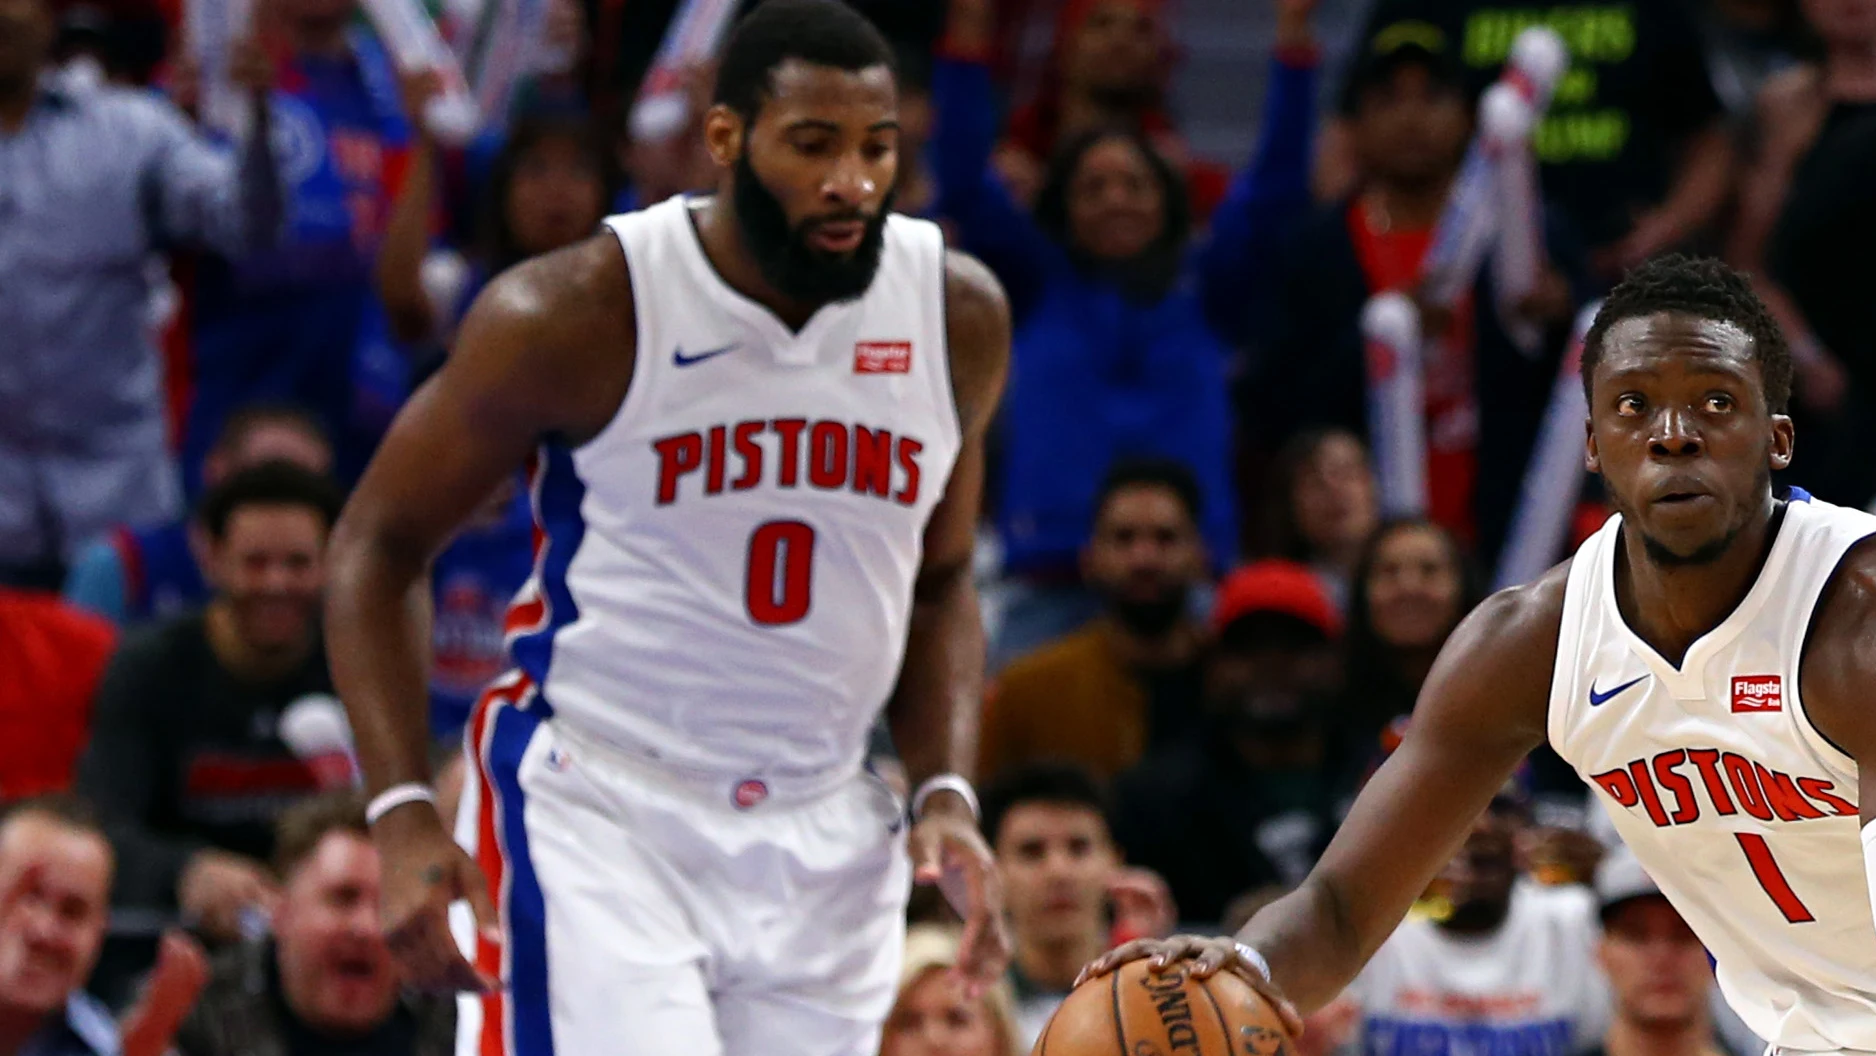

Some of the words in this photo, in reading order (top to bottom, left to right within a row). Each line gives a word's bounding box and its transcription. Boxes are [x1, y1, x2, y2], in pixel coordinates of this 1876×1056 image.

[652, 417, 923, 508] PISTONS
[746, 517, 815, 627] 0
[1734, 680, 1780, 698] Flagsta
[1589, 746, 1860, 828] PISTONS
[1733, 831, 1817, 924] 1
